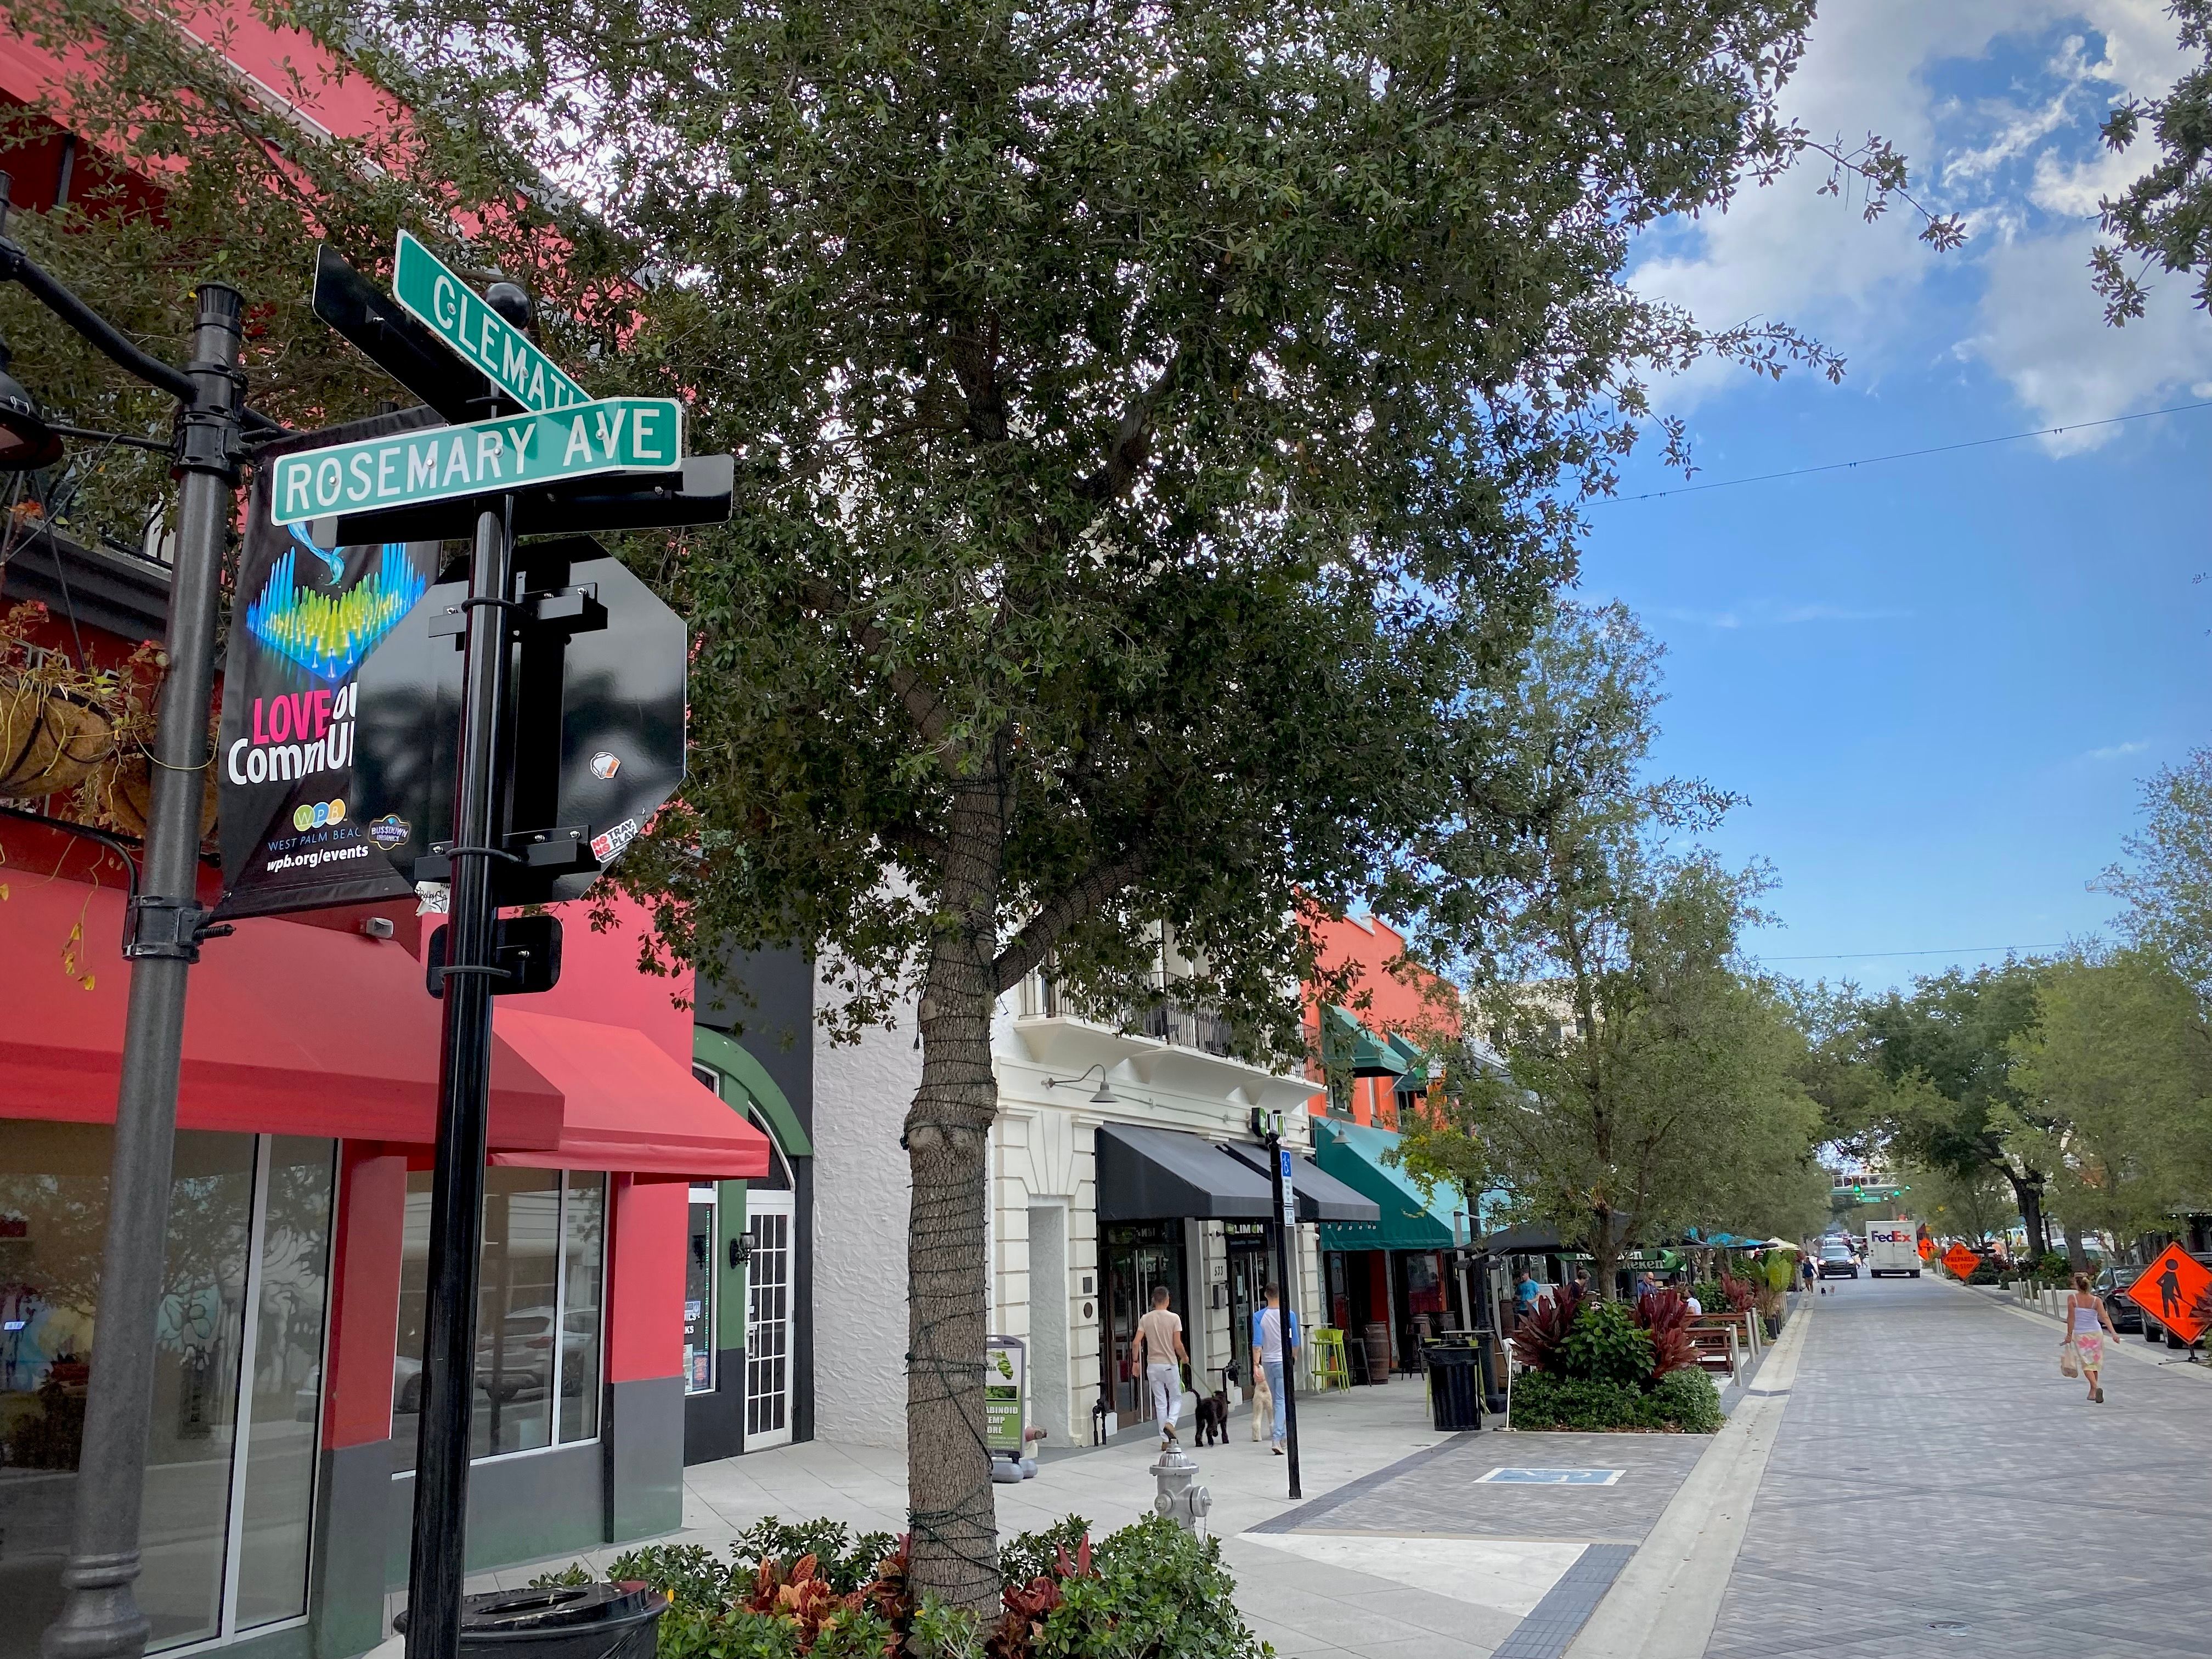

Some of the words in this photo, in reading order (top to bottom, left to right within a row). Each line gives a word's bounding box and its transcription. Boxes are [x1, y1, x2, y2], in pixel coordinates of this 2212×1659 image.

[434, 274, 574, 410] CLEMAT
[286, 423, 537, 512] ROSEMARY
[563, 408, 662, 466] AVE
[253, 689, 331, 745] LOVE
[268, 838, 297, 851] WEST
[300, 831, 328, 845] PALM
[592, 836, 607, 849] NO
[607, 821, 635, 839] TRAY.
[267, 844, 369, 872] wpb.org/events
[595, 844, 611, 856] NO
[1871, 1231, 1912, 1242] FedEx
[987, 1426, 1003, 1435] ORE
[988, 1416, 1006, 1425] EMP
